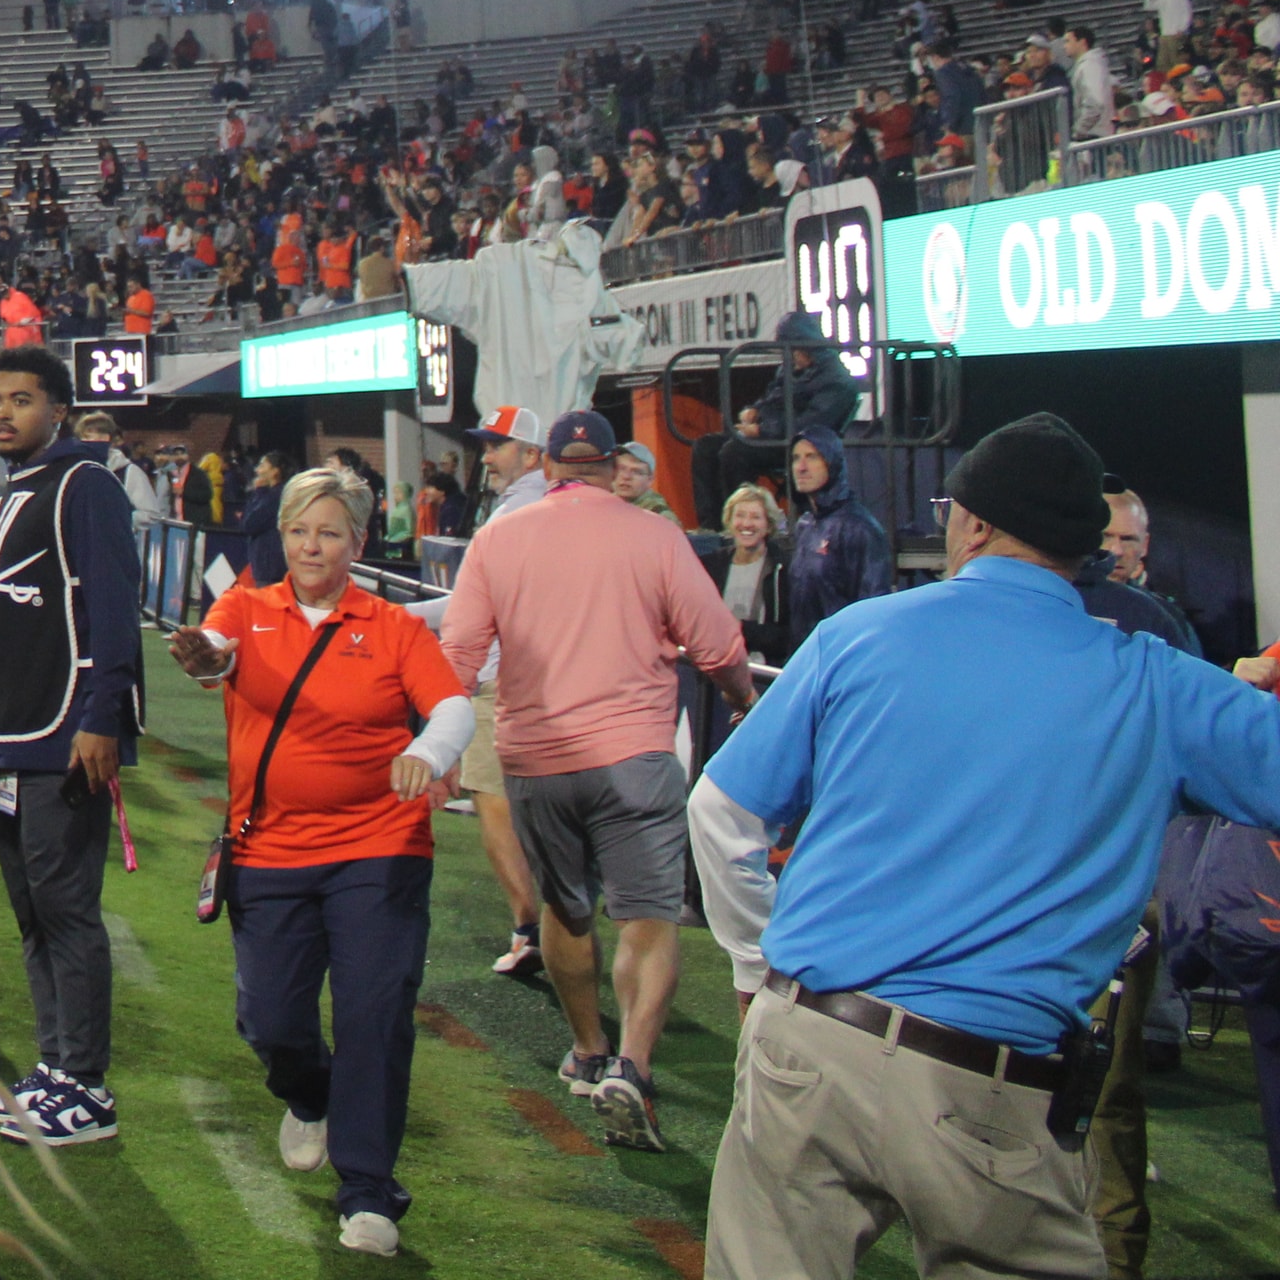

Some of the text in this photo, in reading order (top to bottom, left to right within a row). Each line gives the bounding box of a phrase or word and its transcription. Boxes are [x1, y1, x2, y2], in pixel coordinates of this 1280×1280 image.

[998, 212, 1117, 329] OLD
[679, 298, 696, 344] III
[705, 291, 759, 342] FIELD
[90, 350, 143, 392] 2:24
